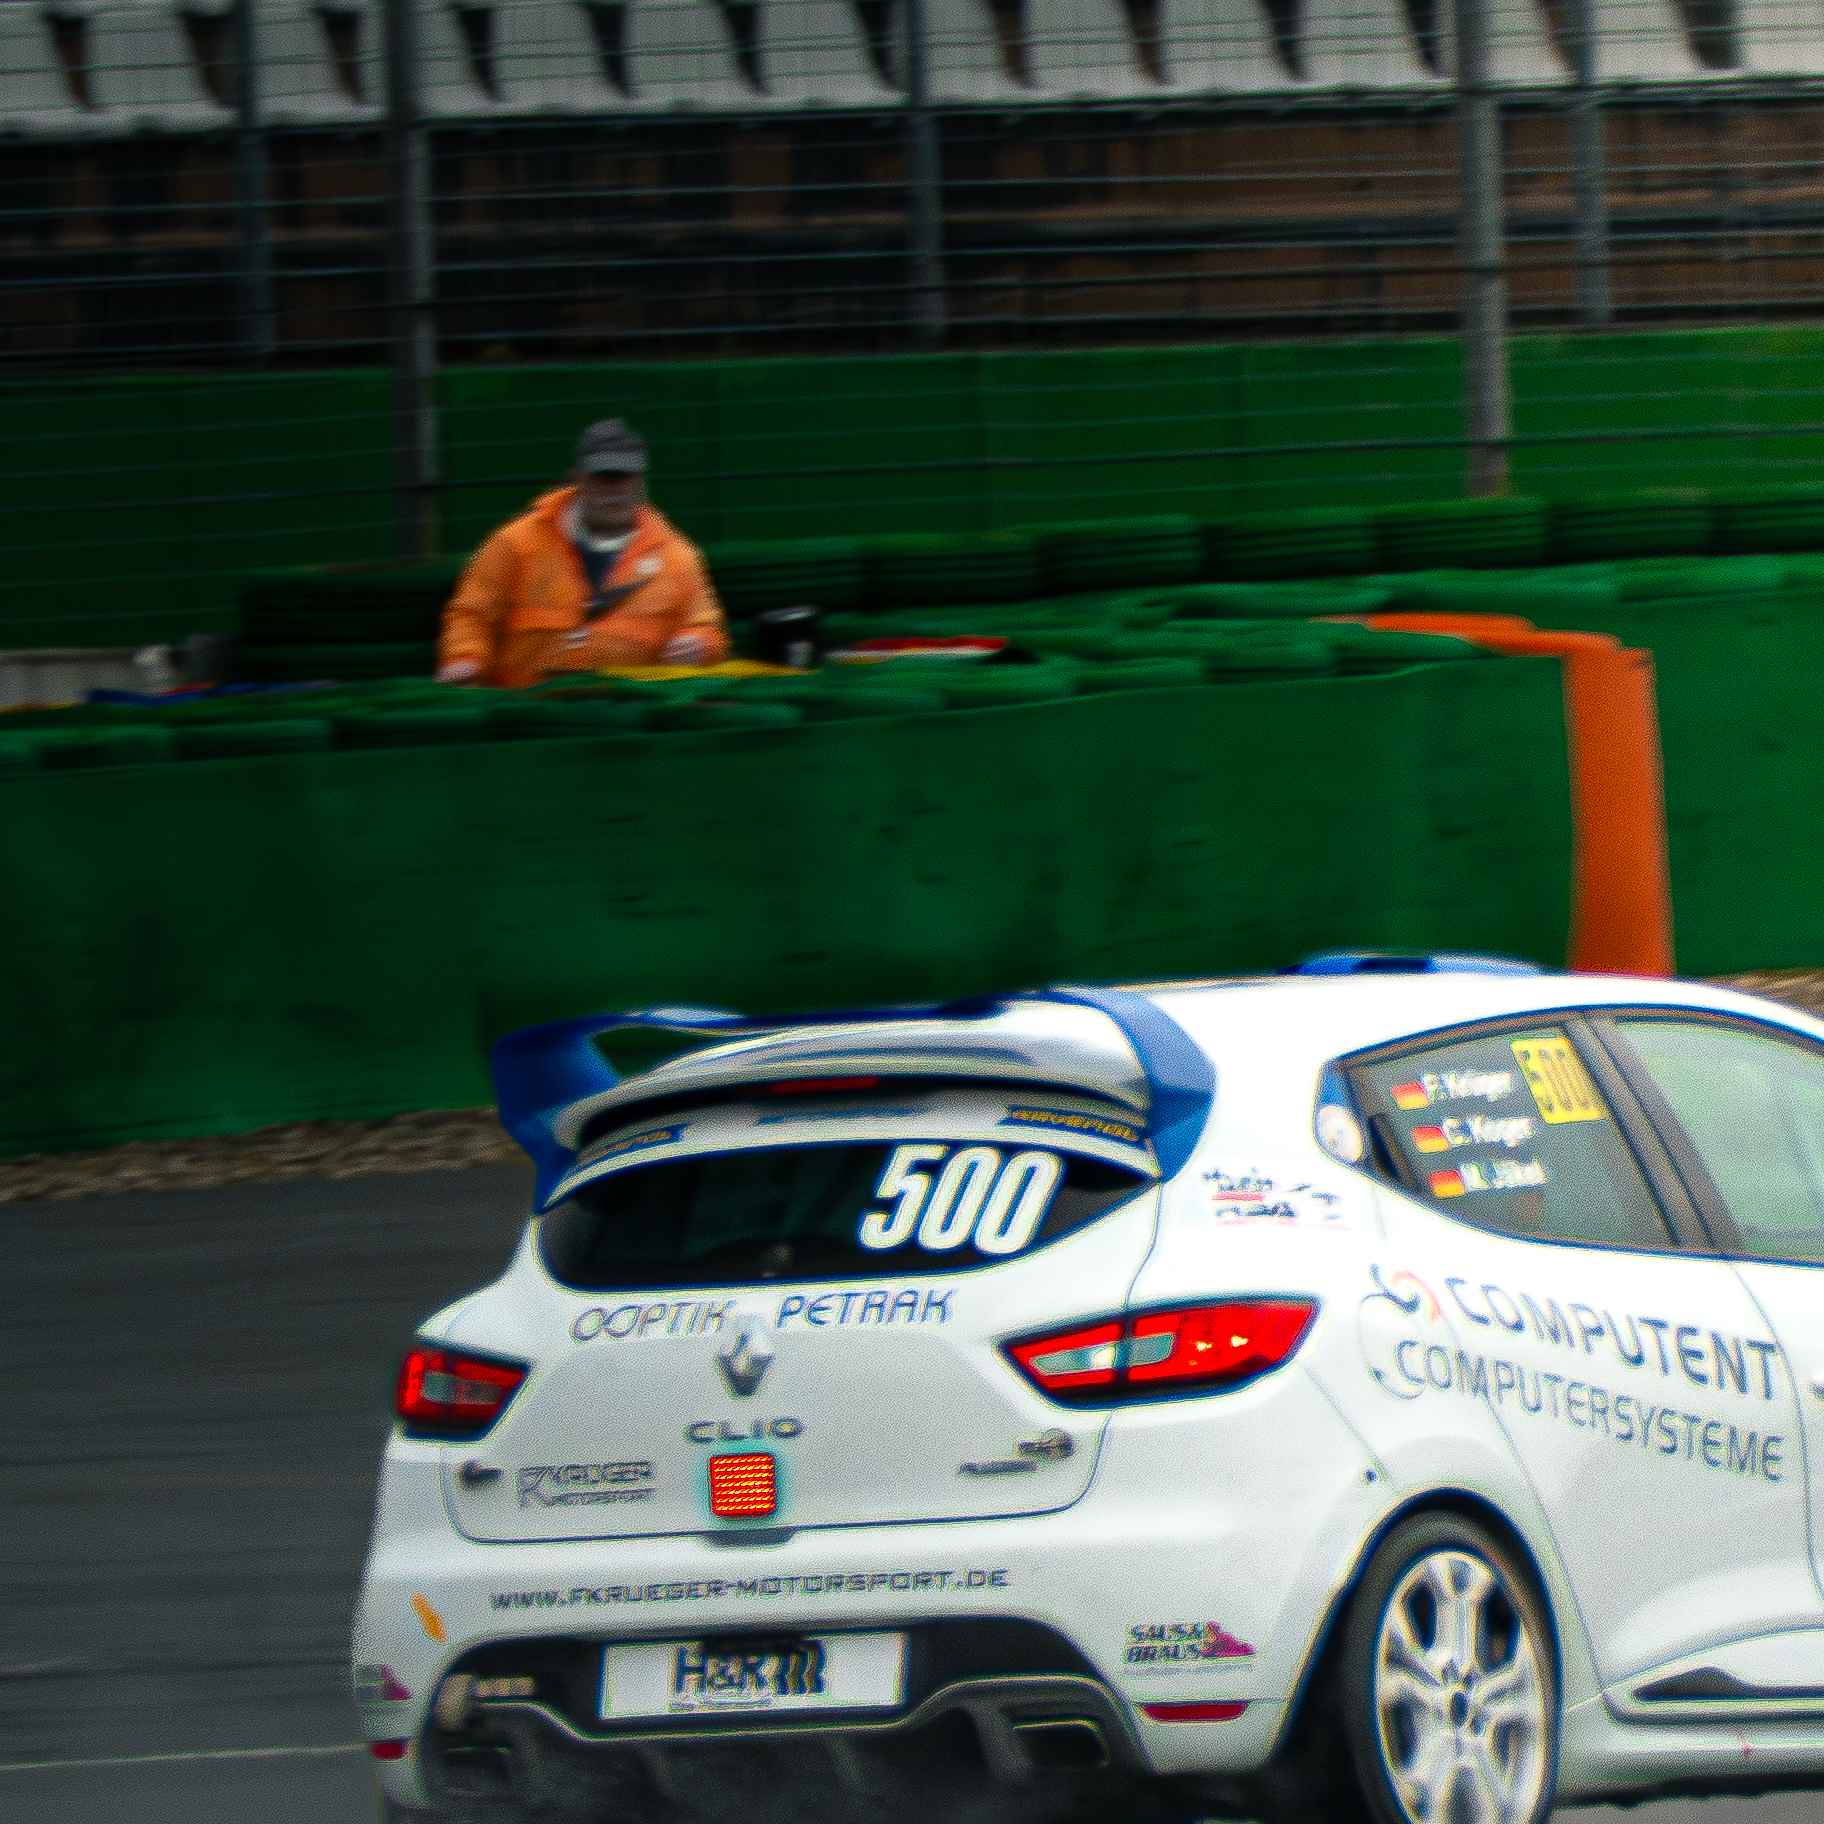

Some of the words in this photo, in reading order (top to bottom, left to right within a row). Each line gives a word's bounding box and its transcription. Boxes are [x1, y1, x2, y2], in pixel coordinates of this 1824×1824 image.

[1517, 1048, 1595, 1113] 500
[860, 1144, 1063, 1255] 500
[774, 1288, 957, 1329] PETRAK
[1444, 1276, 1778, 1400] COMPUTENT
[684, 1416, 805, 1443] CLIO
[1393, 1338, 1787, 1483] COMPUTERSYSTEME
[489, 1567, 1010, 1611] WWW.FKRUEGER-MOTORSPORT.DE
